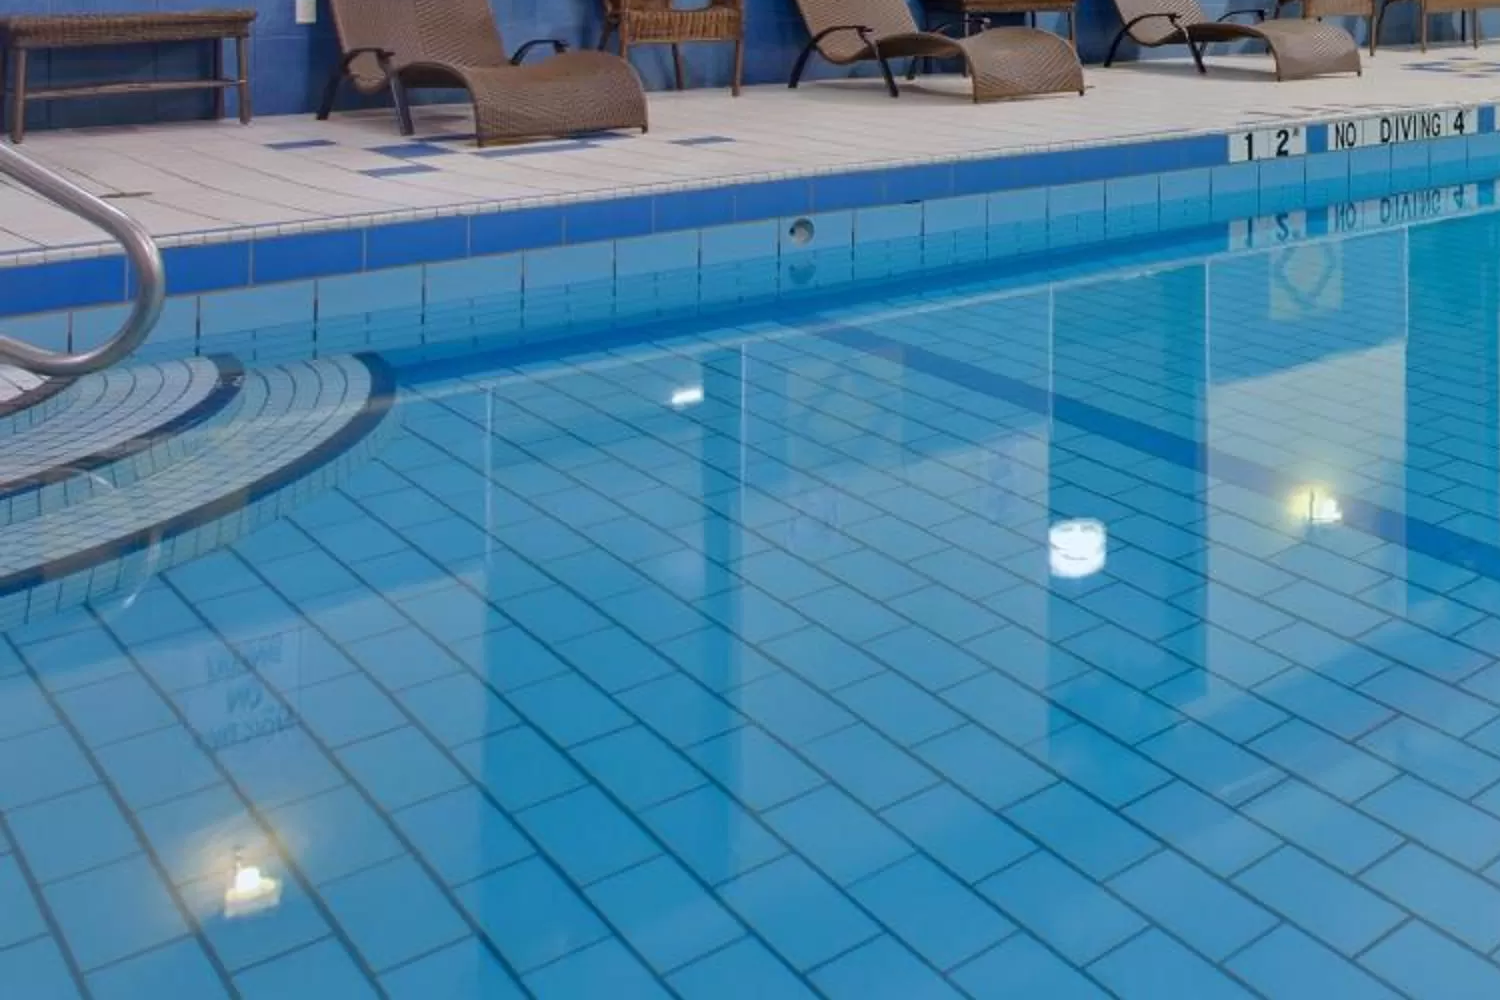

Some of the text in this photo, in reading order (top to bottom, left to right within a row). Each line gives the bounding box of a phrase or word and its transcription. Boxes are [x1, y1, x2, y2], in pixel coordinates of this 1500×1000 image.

[1244, 132, 1253, 161] 1
[1335, 110, 1465, 149] NO DIVING 4
